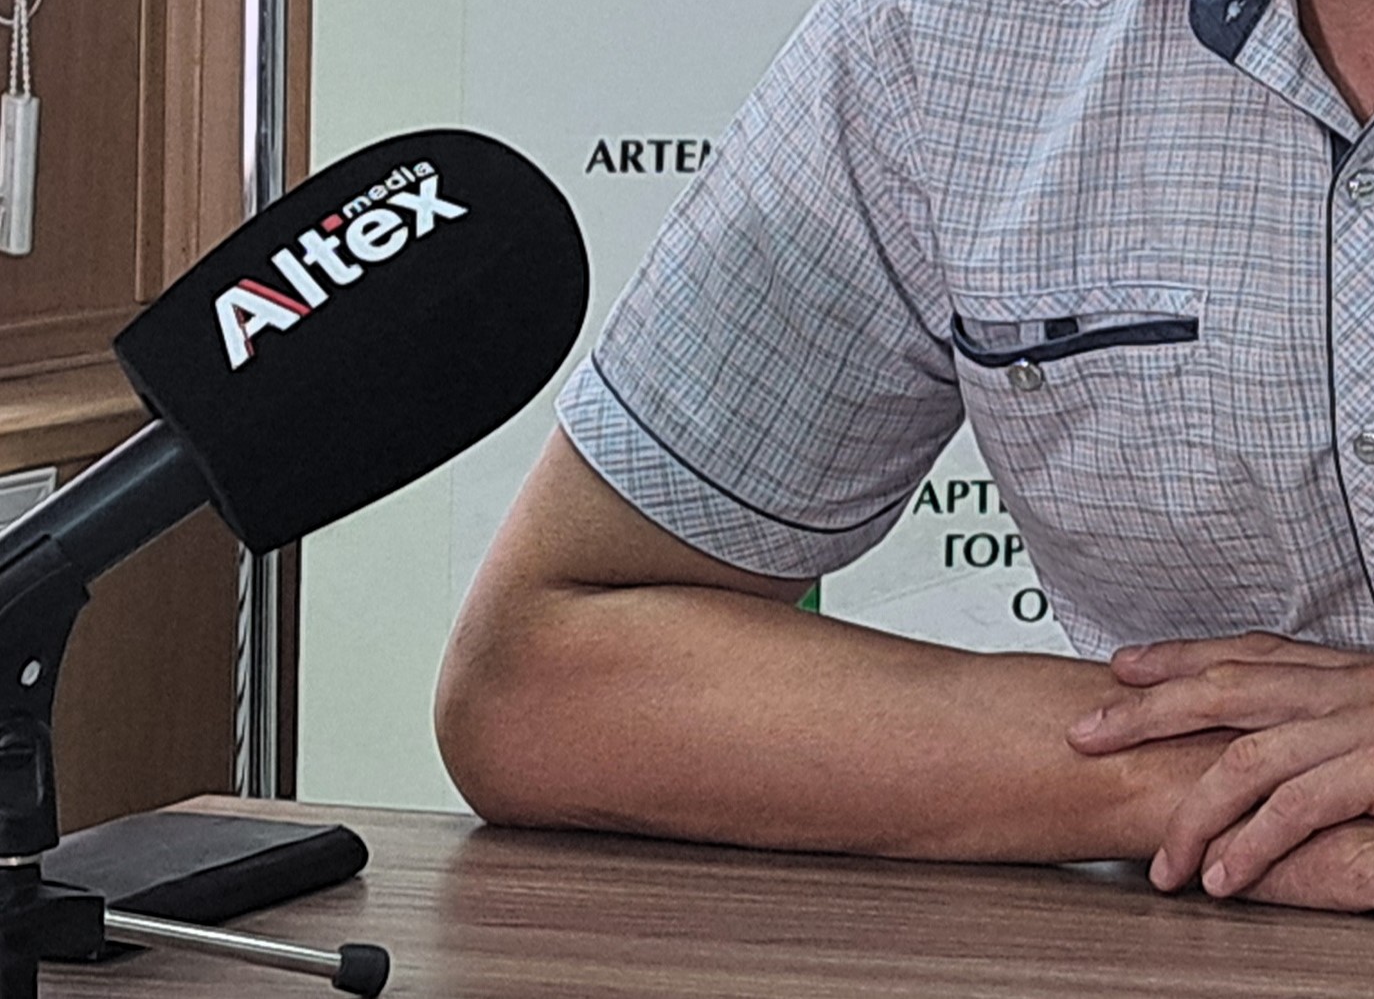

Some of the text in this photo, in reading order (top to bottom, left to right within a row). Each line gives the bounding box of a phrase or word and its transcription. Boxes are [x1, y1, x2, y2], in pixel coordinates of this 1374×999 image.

[342, 161, 436, 219] media
[214, 175, 469, 371] Altex
[913, 480, 1009, 514] АРТ
